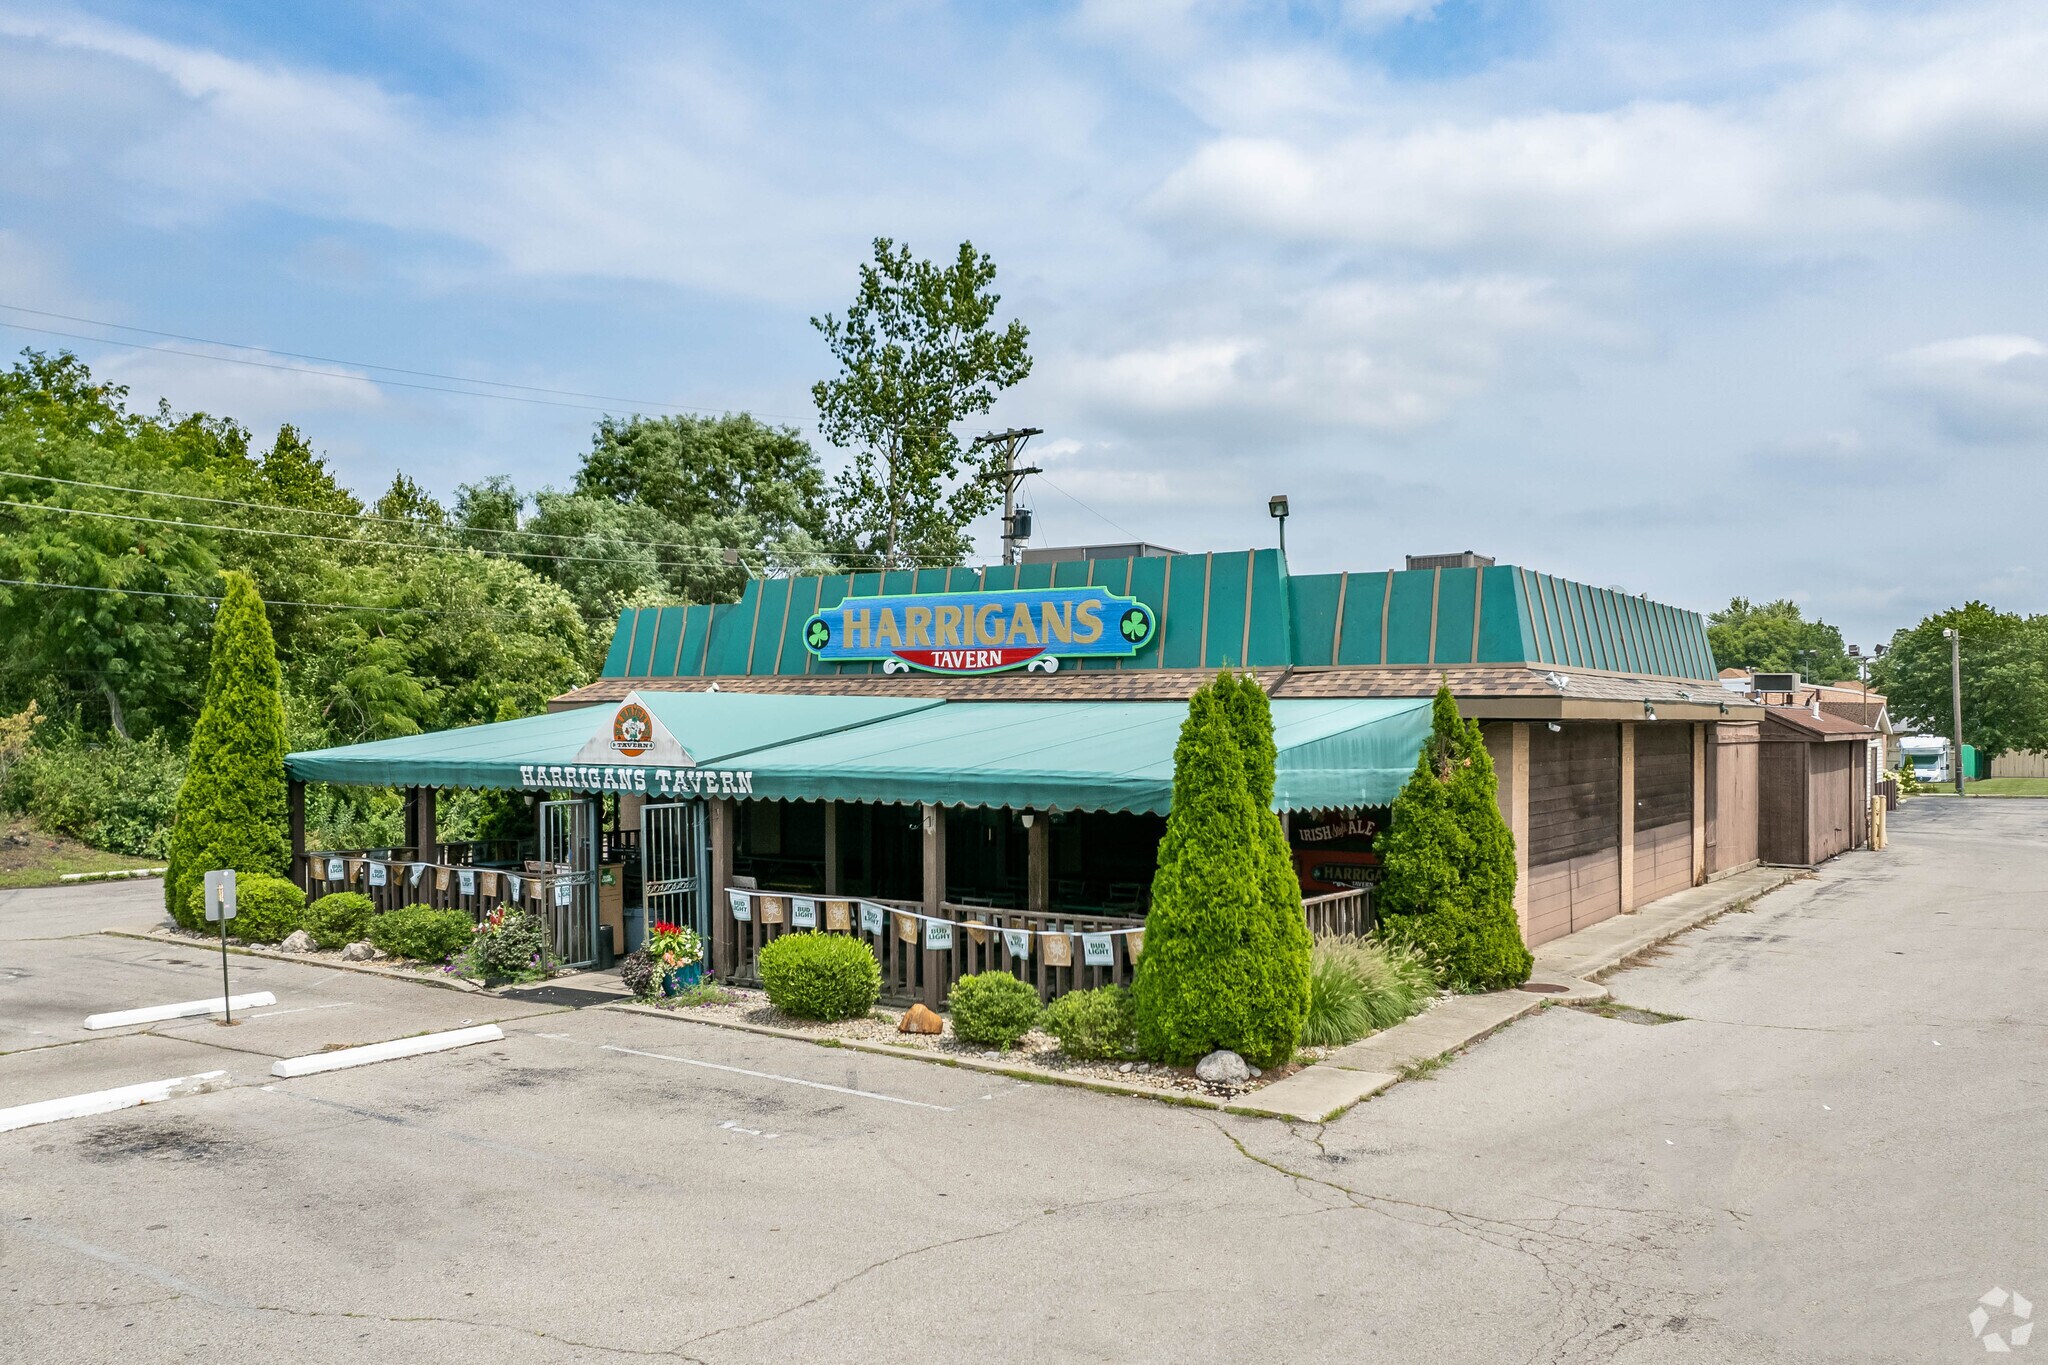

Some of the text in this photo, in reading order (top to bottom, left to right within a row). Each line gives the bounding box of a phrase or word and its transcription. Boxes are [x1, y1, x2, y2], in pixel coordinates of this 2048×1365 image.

[843, 599, 1104, 648] HARRIGANS
[931, 650, 1002, 669] TAVERN
[519, 765, 753, 794] HARRIGANS TAVERN
[1299, 825, 1332, 840] IRISH
[1349, 820, 1376, 836] ALE
[1324, 866, 1383, 882] HARRIGA
[734, 905, 748, 913] IGHT
[795, 911, 813, 919] LIGHT
[928, 933, 950, 941] LIGHT
